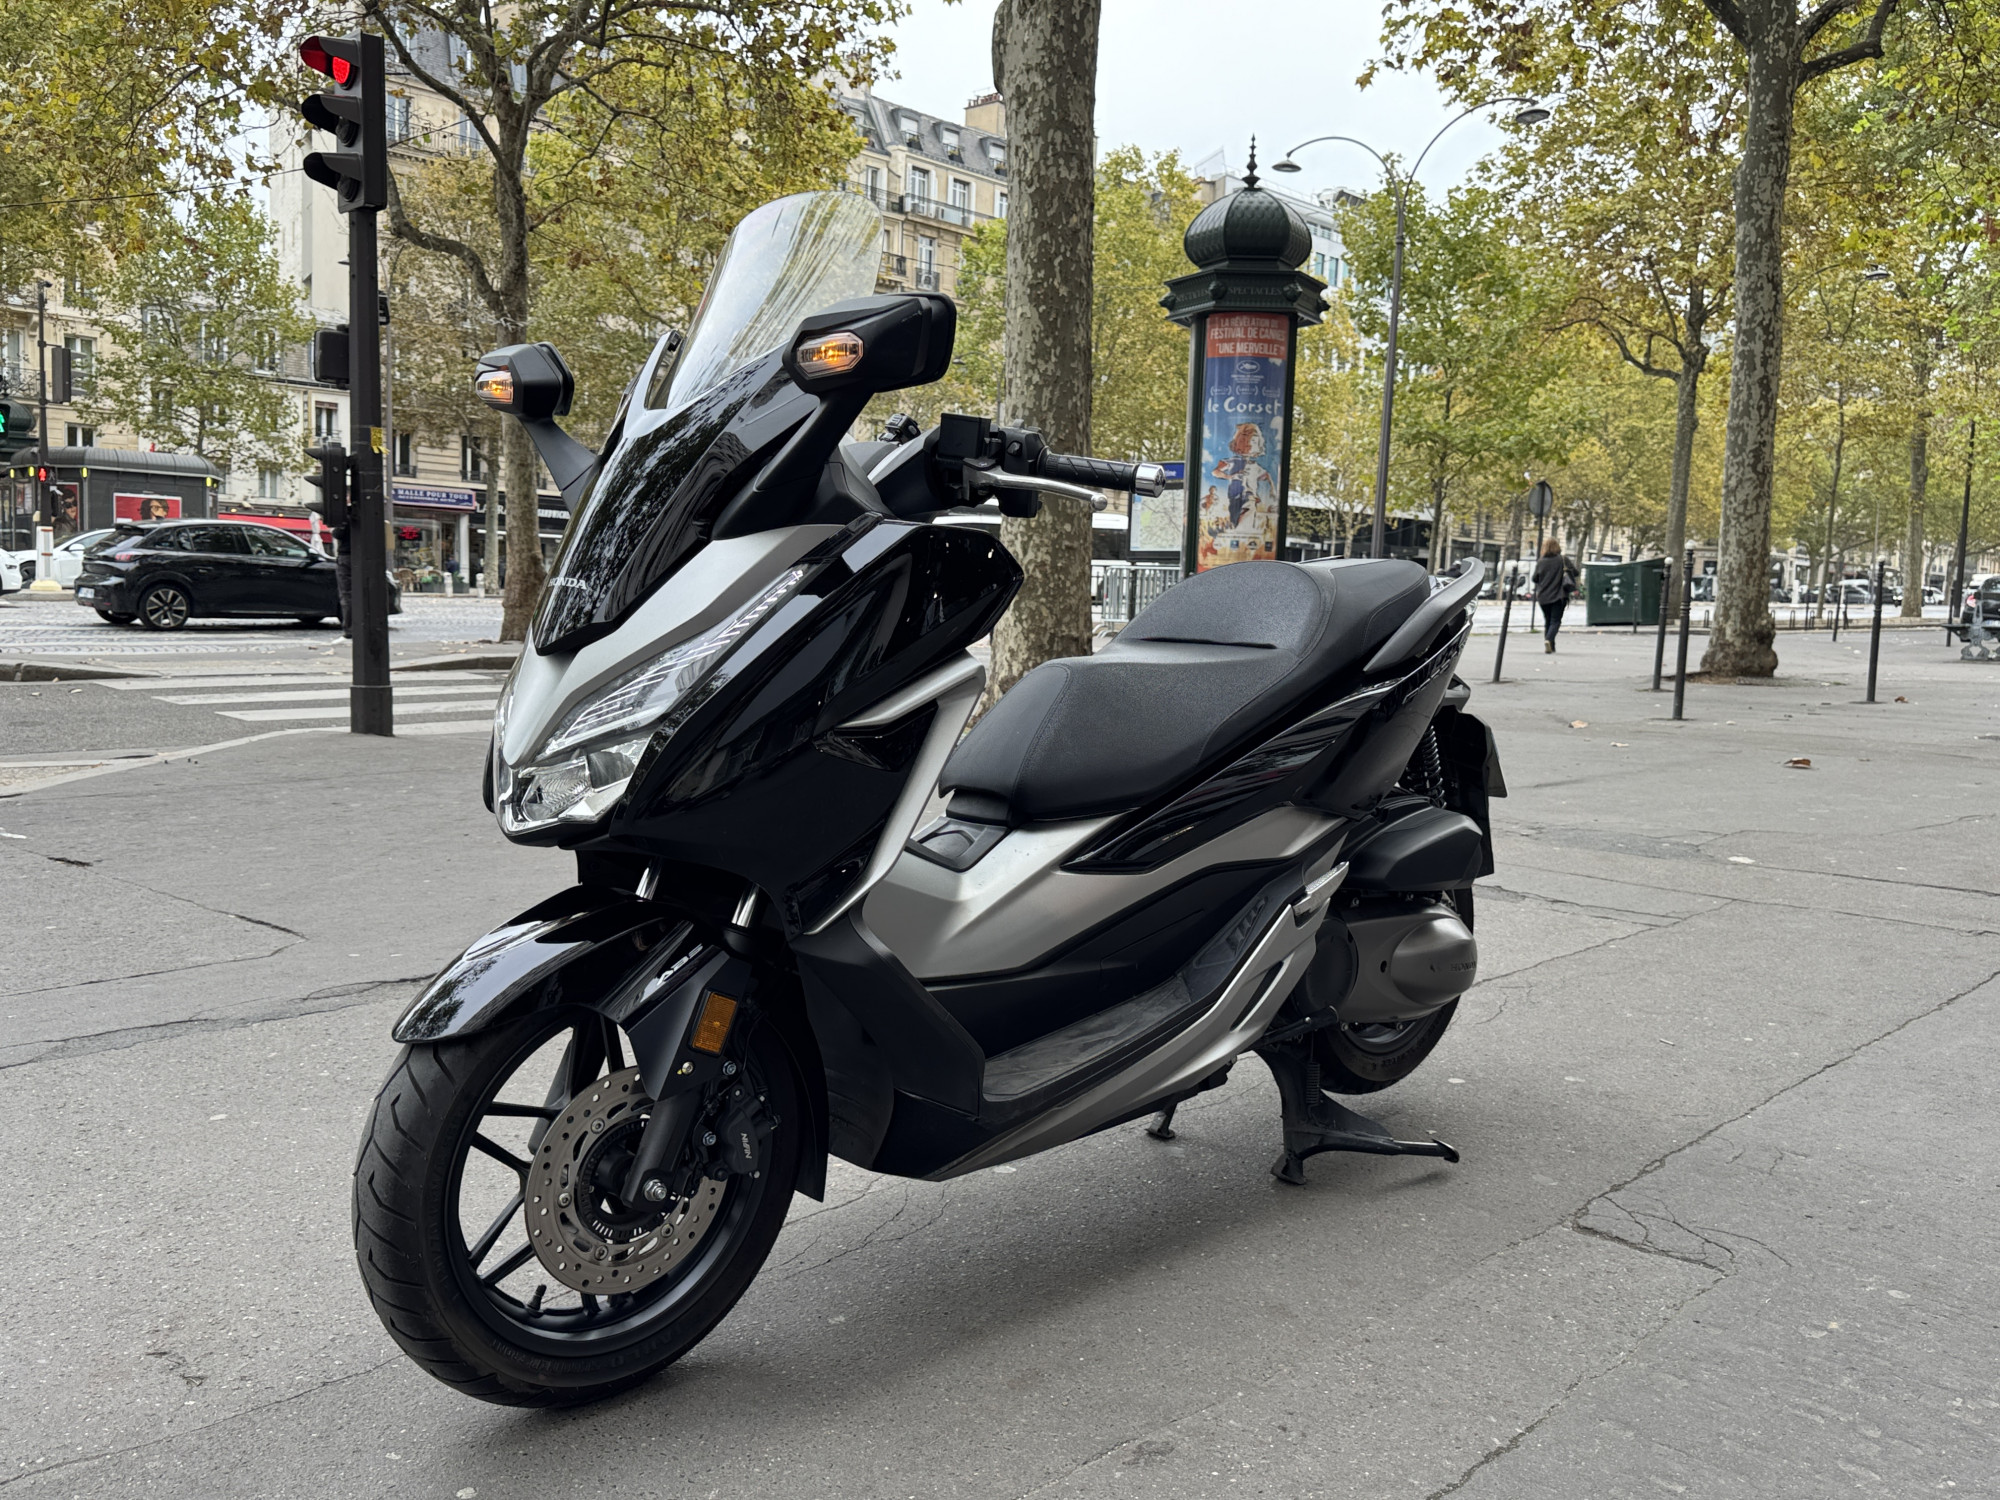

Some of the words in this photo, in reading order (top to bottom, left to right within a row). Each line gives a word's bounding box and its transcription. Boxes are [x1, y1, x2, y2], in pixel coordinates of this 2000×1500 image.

[1228, 287, 1281, 296] SPECTACLES
[1221, 318, 1229, 327] LA
[1210, 327, 1246, 339] FESTIVAL
[1247, 327, 1258, 339] DE
[1223, 396, 1282, 415] Corset
[397, 488, 425, 496] MALLE
[426, 490, 447, 498] POUR
